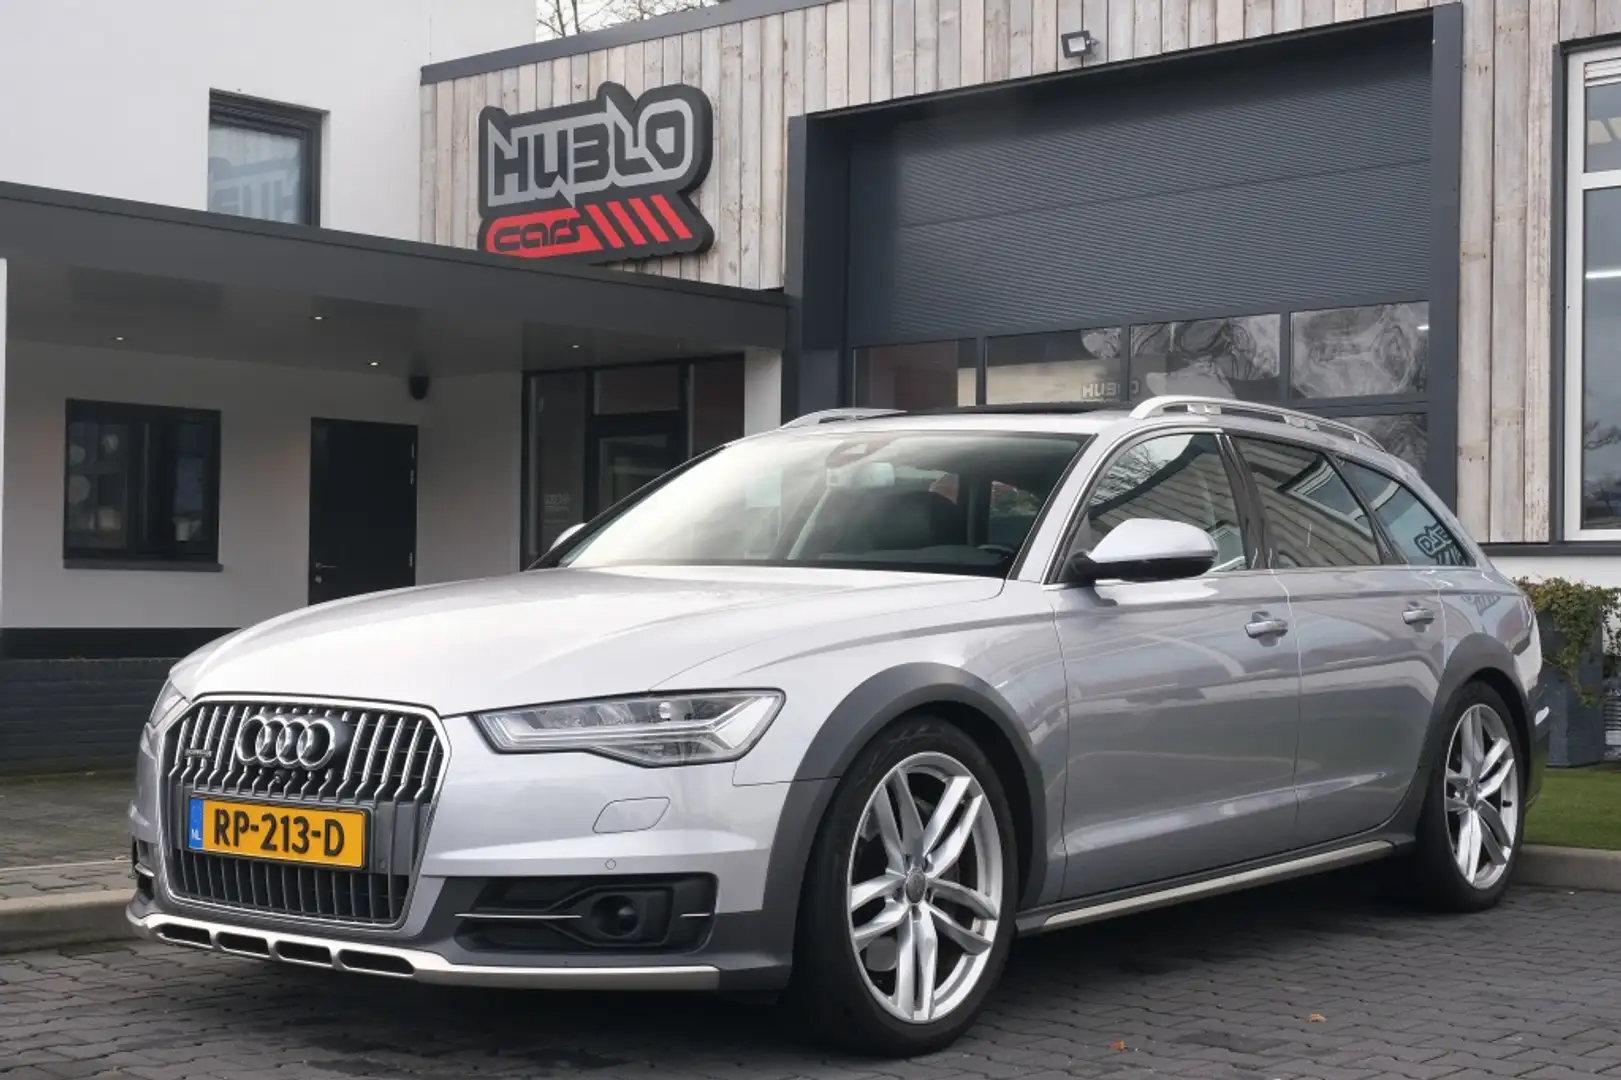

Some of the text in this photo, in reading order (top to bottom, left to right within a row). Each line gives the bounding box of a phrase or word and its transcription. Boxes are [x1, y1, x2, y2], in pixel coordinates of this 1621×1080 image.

[489, 98, 692, 206] HUBLO
[494, 217, 581, 251] cars
[1082, 380, 1140, 399] HUBO
[191, 828, 202, 841] NL
[213, 808, 345, 857] RP-213-D
